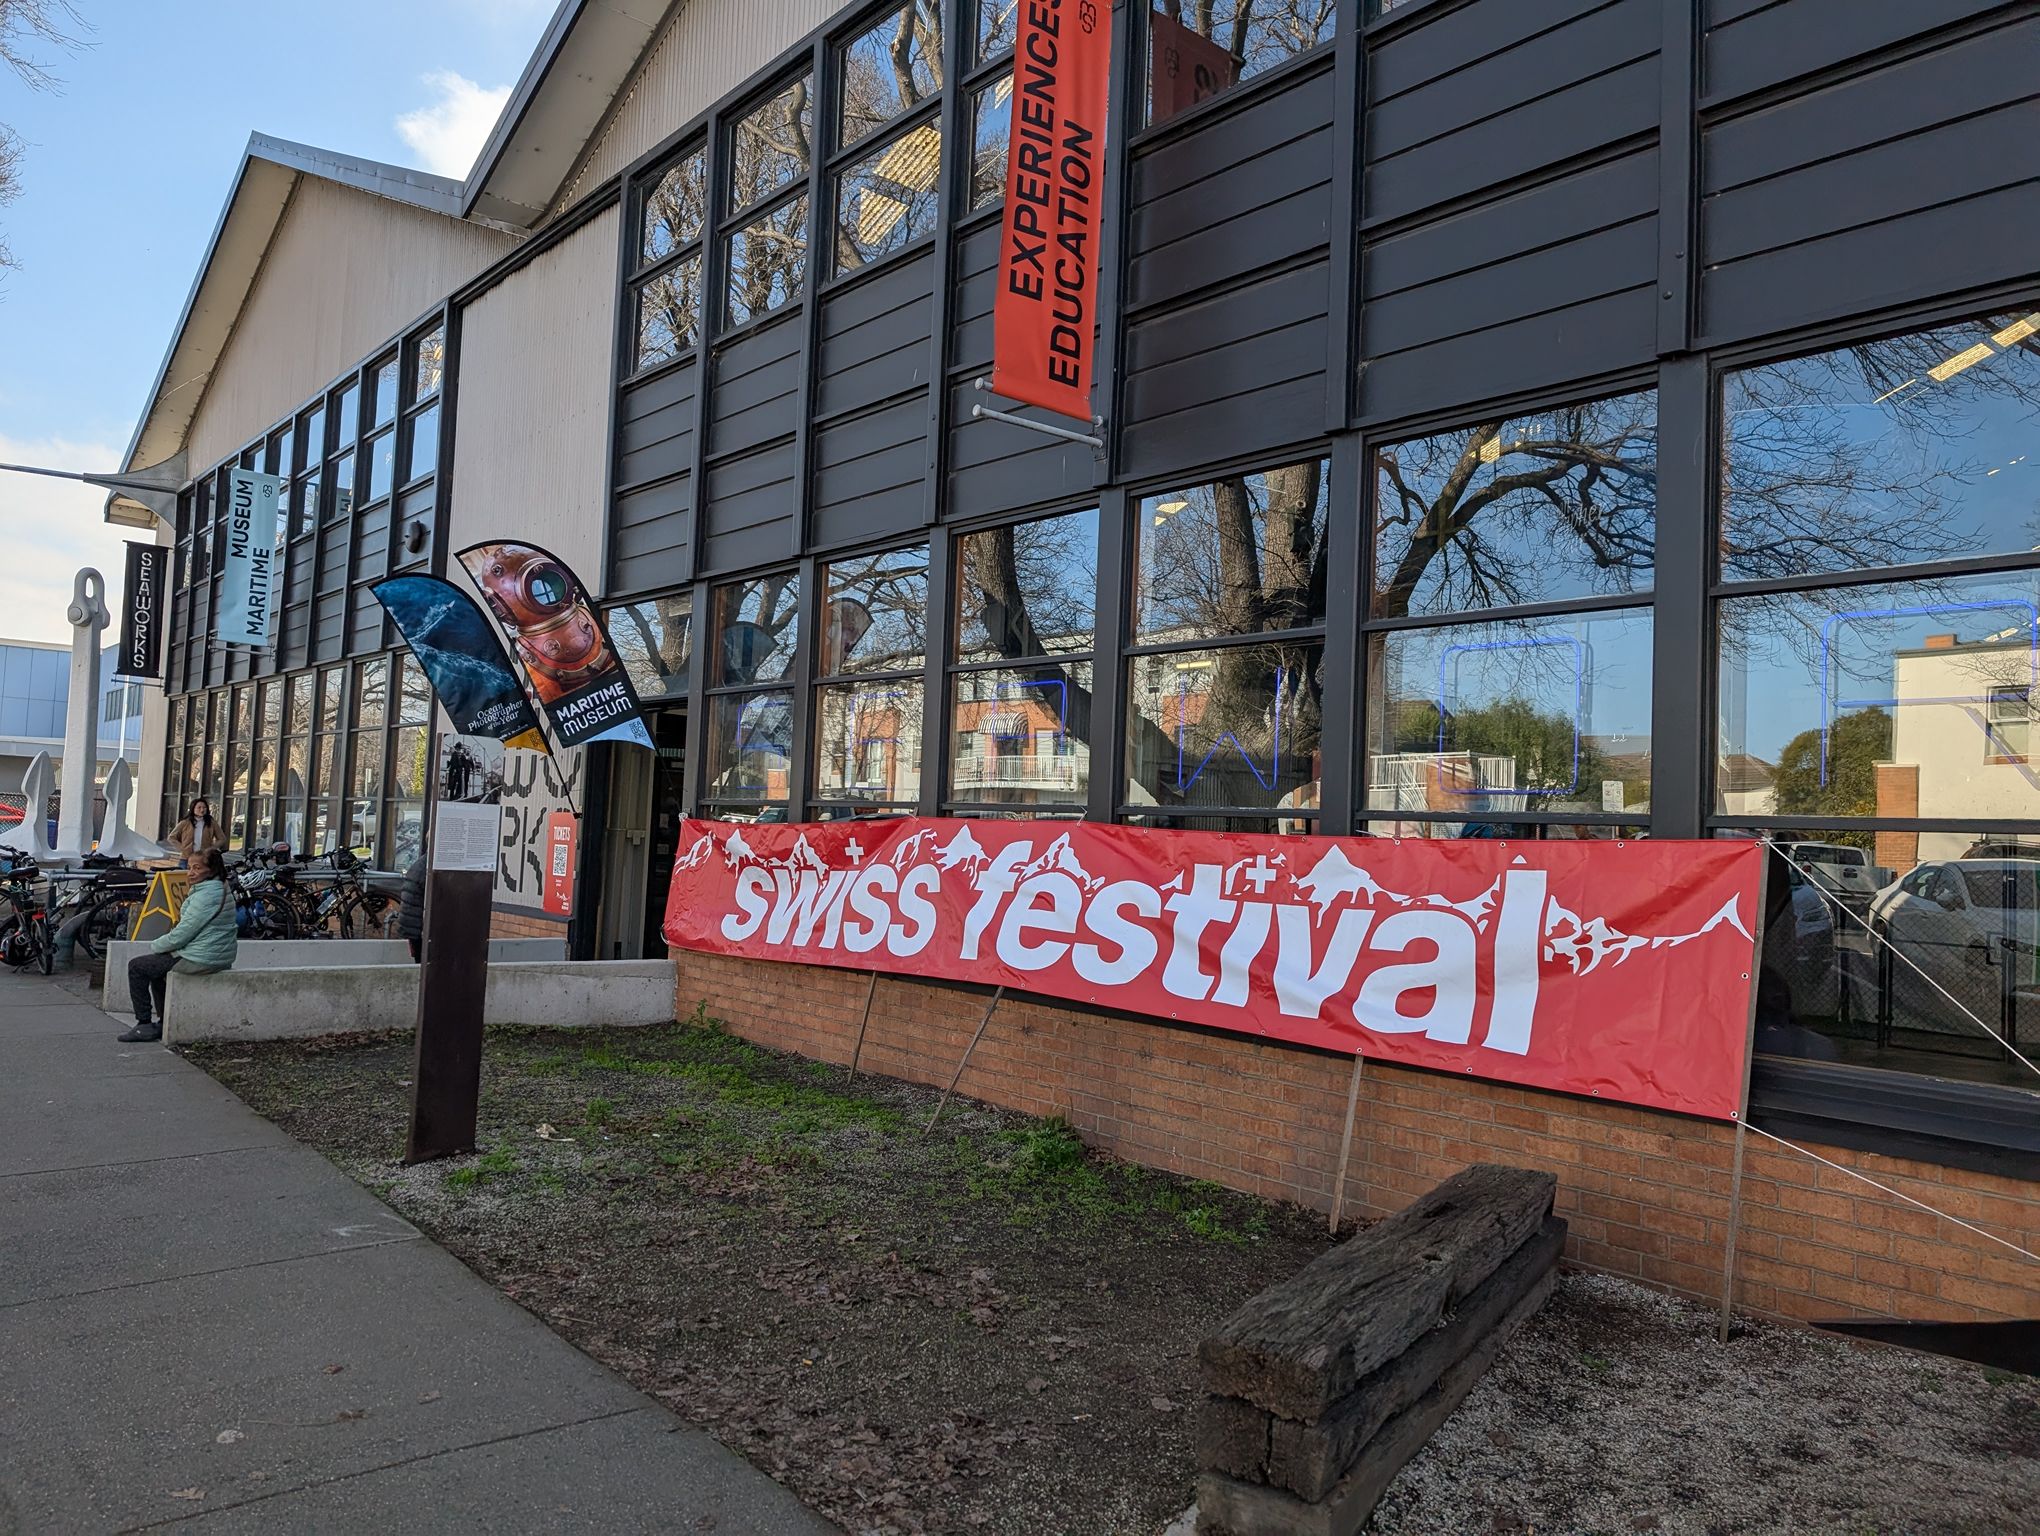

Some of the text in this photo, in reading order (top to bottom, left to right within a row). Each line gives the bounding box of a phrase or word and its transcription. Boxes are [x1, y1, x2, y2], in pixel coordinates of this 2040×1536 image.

[1008, 0, 1061, 301] EXPERIENCE
[1049, 120, 1094, 388] EDUCATION
[231, 479, 254, 558] MUSEUM
[133, 552, 153, 669] SEAWORKS
[246, 547, 270, 636] MARITIME
[467, 699, 524, 732] Photographer
[477, 702, 504, 720] Ocean
[500, 710, 519, 725] Year
[556, 681, 626, 722] MARITIME
[563, 696, 633, 737] MUSEUM
[553, 826, 571, 841] TICKETS
[720, 838, 1547, 1056] swiss festival
